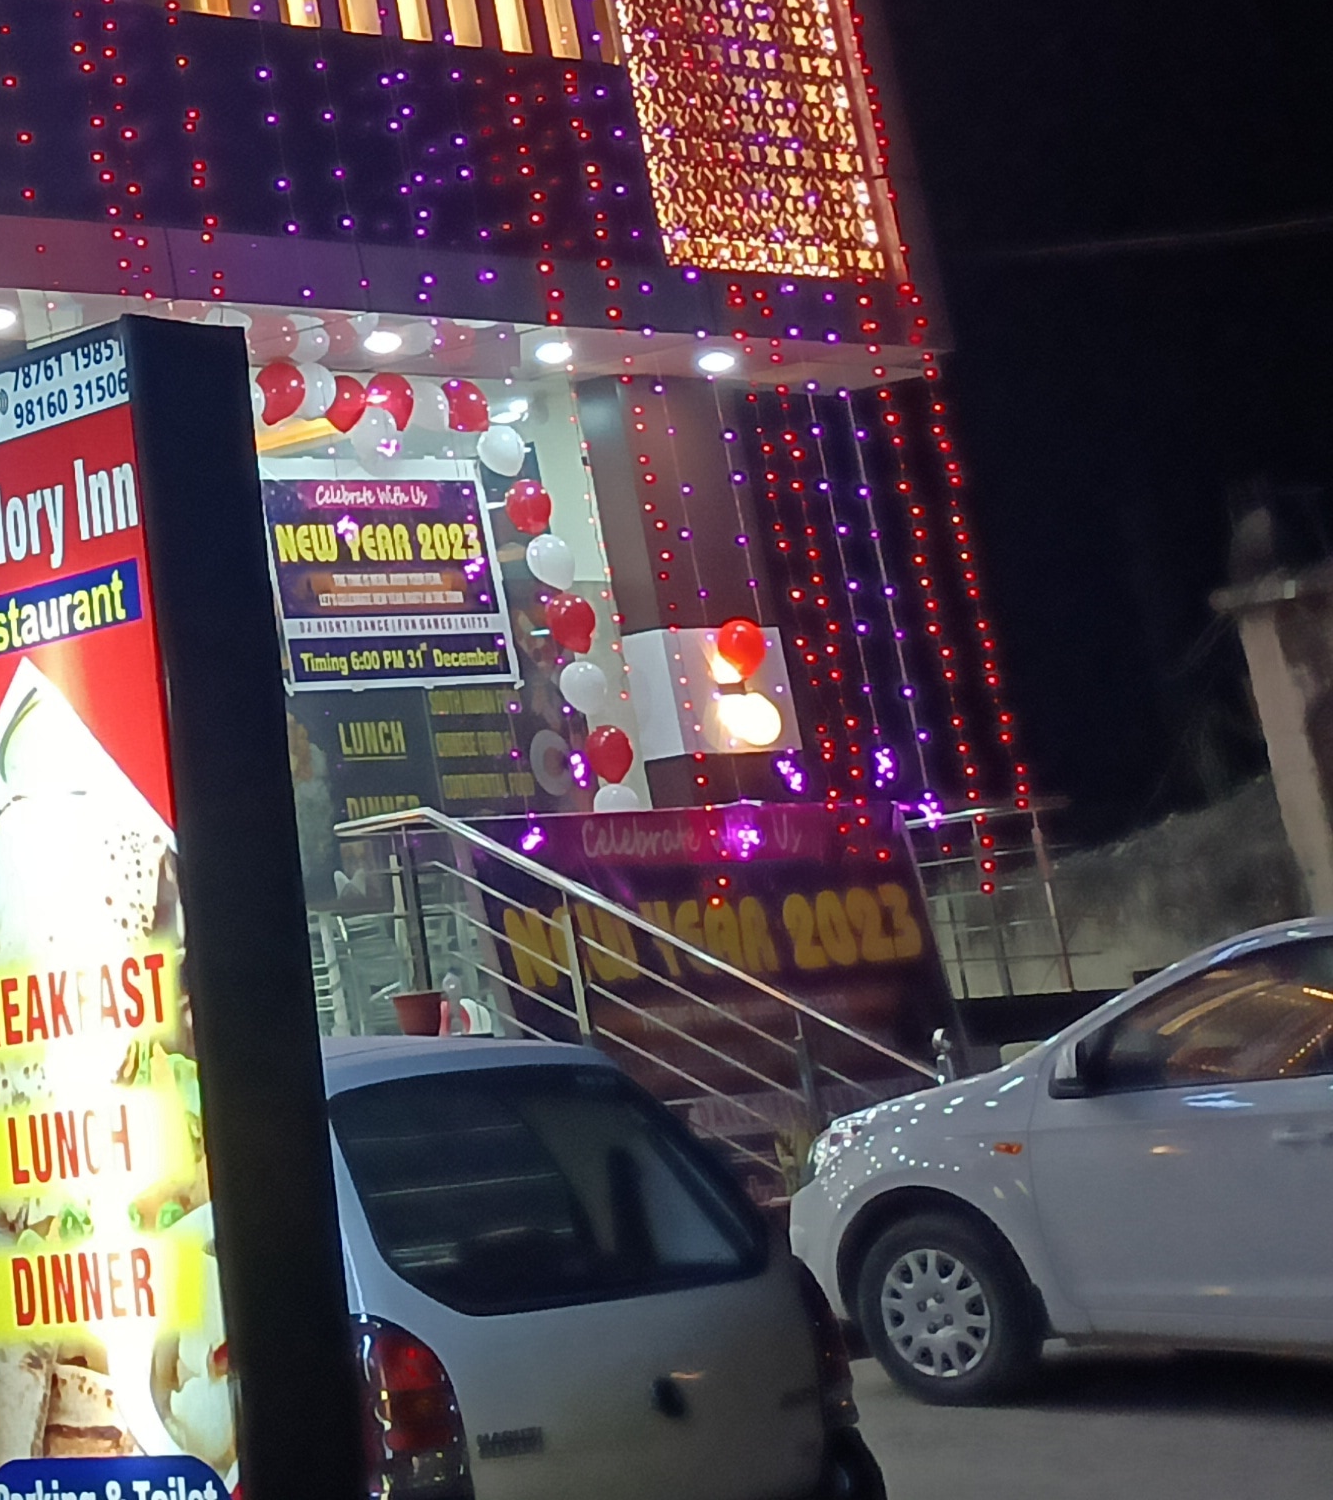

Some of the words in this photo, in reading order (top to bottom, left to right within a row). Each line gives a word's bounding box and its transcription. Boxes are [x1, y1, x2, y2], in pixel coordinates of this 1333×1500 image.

[13, 388, 68, 429] 98160
[73, 367, 129, 410] 31506
[73, 458, 139, 541] Inn
[315, 485, 375, 507] Celebrate
[377, 484, 409, 506] With
[410, 484, 429, 507] Us
[275, 524, 339, 562] NEW
[339, 522, 414, 562] YEAR
[416, 523, 482, 561] 2023
[317, 620, 348, 633] NIGHT
[357, 619, 389, 632] DANCE
[397, 618, 417, 631] FUN
[460, 616, 489, 630] GIFTS
[300, 651, 349, 676] Timing
[350, 650, 380, 670] 6:00
[383, 649, 405, 669] PM
[433, 647, 499, 668] December
[338, 720, 407, 756] LUNCH
[581, 817, 701, 859] Celebrate
[503, 903, 640, 988] NEW
[639, 895, 780, 978] YEAR
[783, 882, 923, 970] 2023
[7, 1103, 132, 1185] LUNCH
[11, 1246, 157, 1327] DINNER
